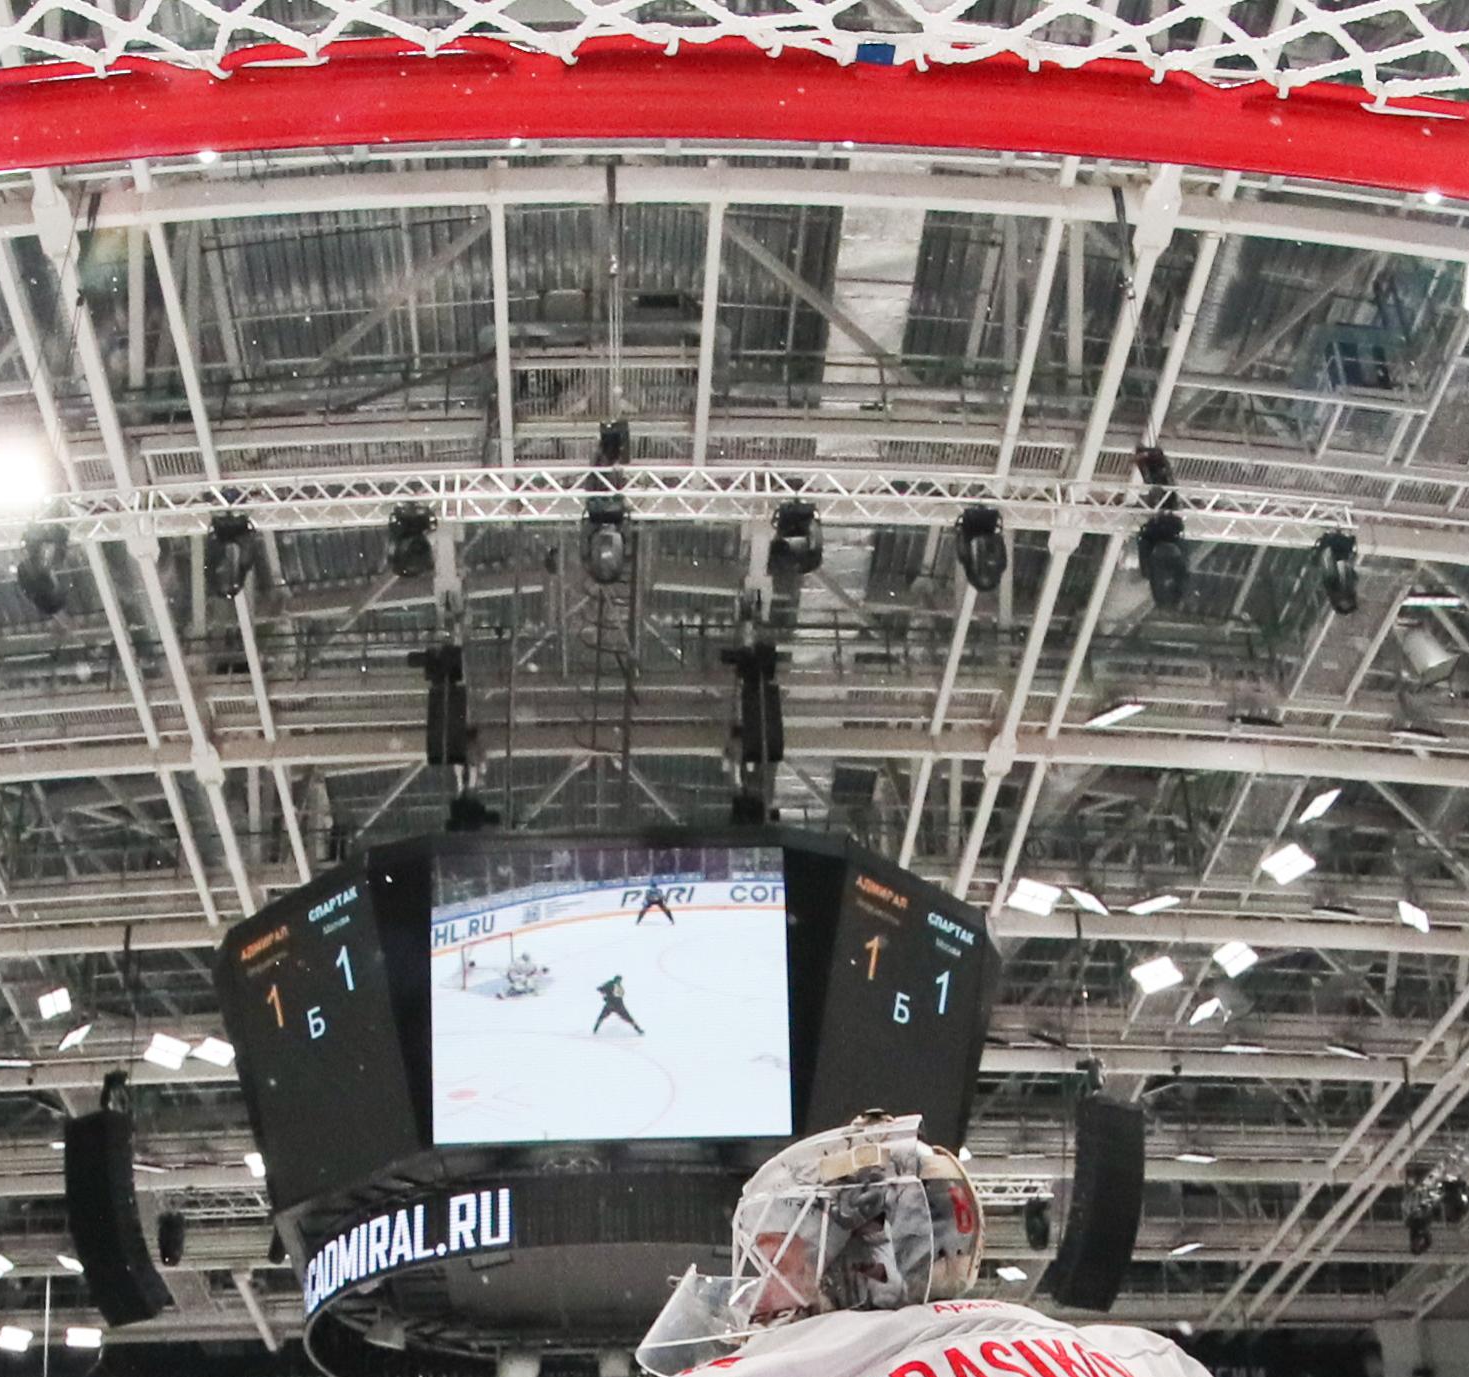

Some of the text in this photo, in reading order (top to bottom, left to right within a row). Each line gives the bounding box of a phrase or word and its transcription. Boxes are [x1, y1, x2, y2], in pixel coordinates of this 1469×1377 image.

[308, 886, 358, 922] СПАРТАК
[620, 886, 694, 907] PRI
[928, 912, 975, 945] СПАРТАК
[335, 945, 354, 991] 1
[864, 935, 880, 981] 1
[267, 984, 284, 1028] 1
[935, 970, 950, 1015] 1
[304, 1188, 510, 1315] CADMIRAL.RU
